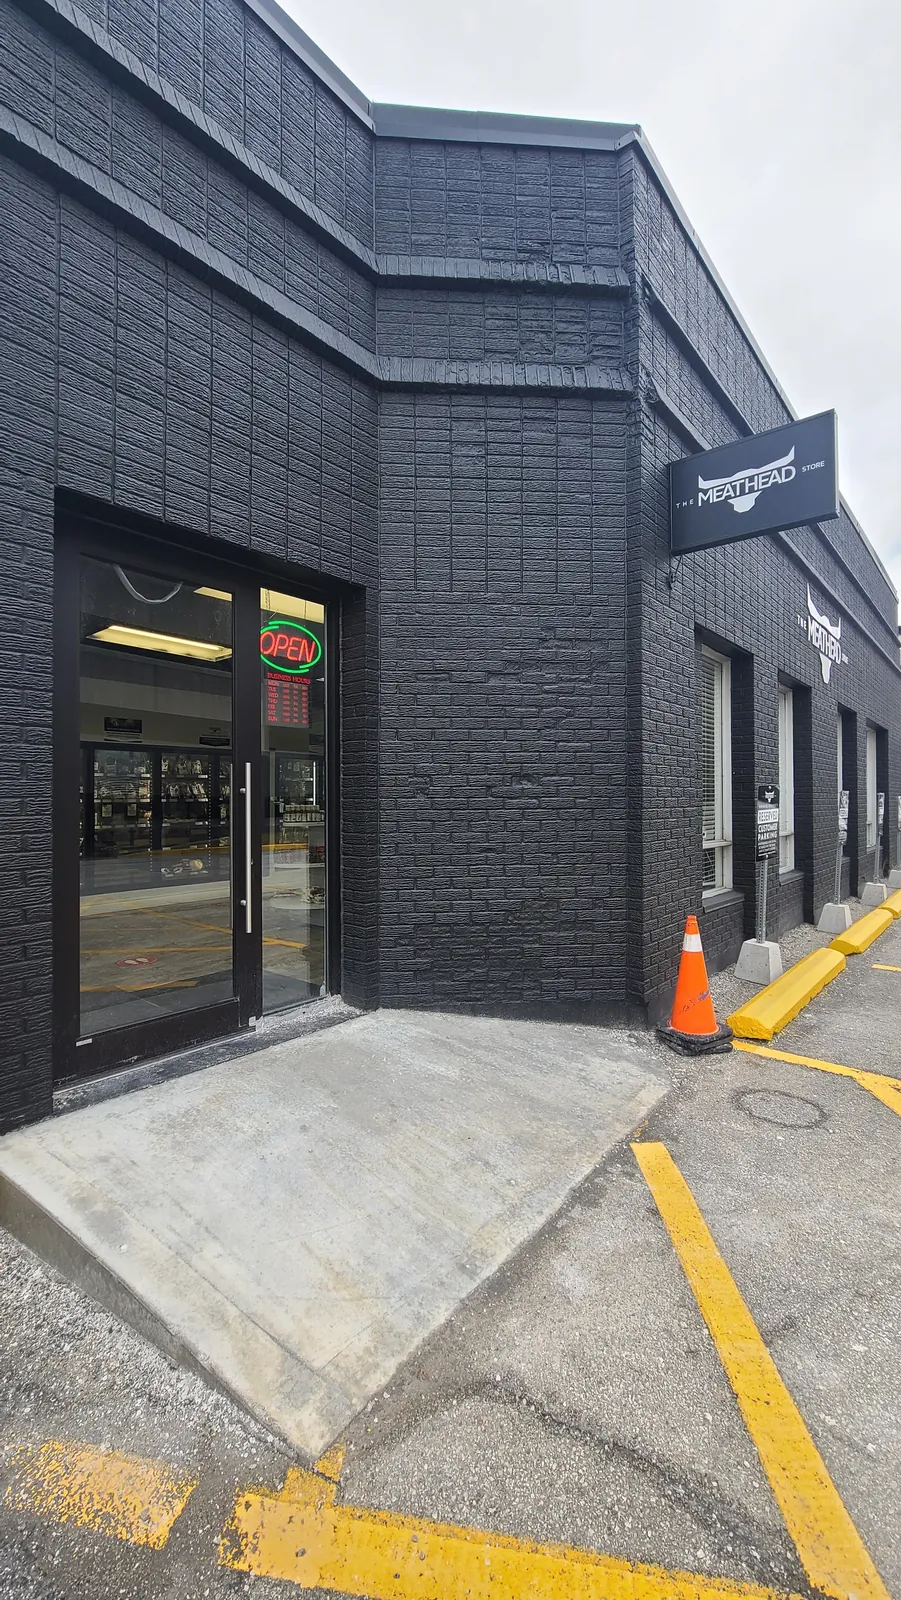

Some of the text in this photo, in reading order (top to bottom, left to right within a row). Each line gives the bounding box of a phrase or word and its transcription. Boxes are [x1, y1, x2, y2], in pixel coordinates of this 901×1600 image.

[675, 460, 825, 508] THE MEATHEAD STORE
[260, 631, 316, 663] OPEN
[797, 614, 842, 665] THE MEATHEAD
[267, 672, 291, 682] BUSINESS
[758, 823, 778, 833] CUSTOMER
[758, 831, 778, 842] PARKING
